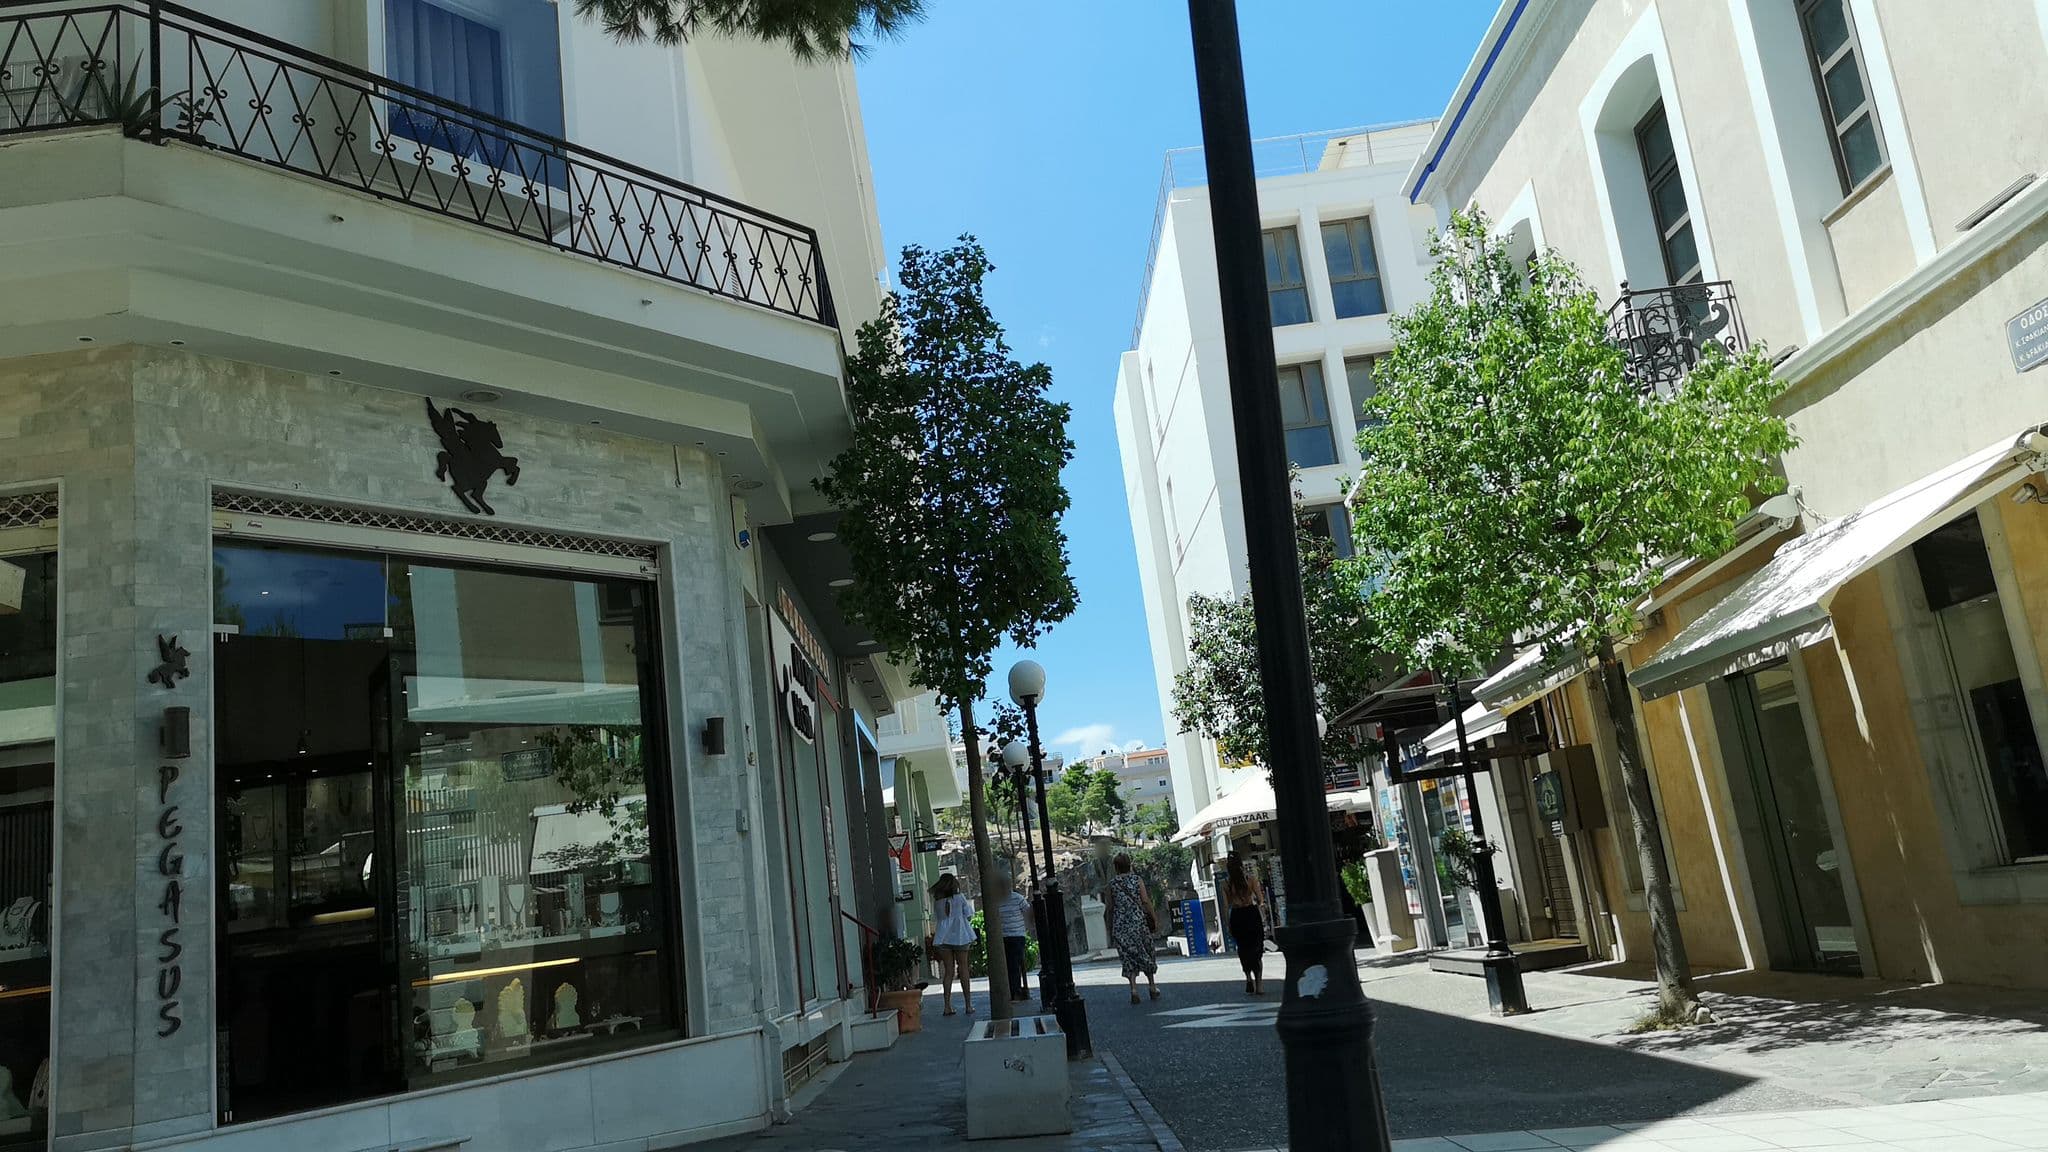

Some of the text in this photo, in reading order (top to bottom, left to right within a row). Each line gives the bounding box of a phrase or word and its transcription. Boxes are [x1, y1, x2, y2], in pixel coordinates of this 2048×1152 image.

[2020, 305, 2048, 329] ΟΔΟΣ
[1215, 811, 1270, 828] CITY BAZAAR
[157, 766, 184, 1038] PEGASUS
